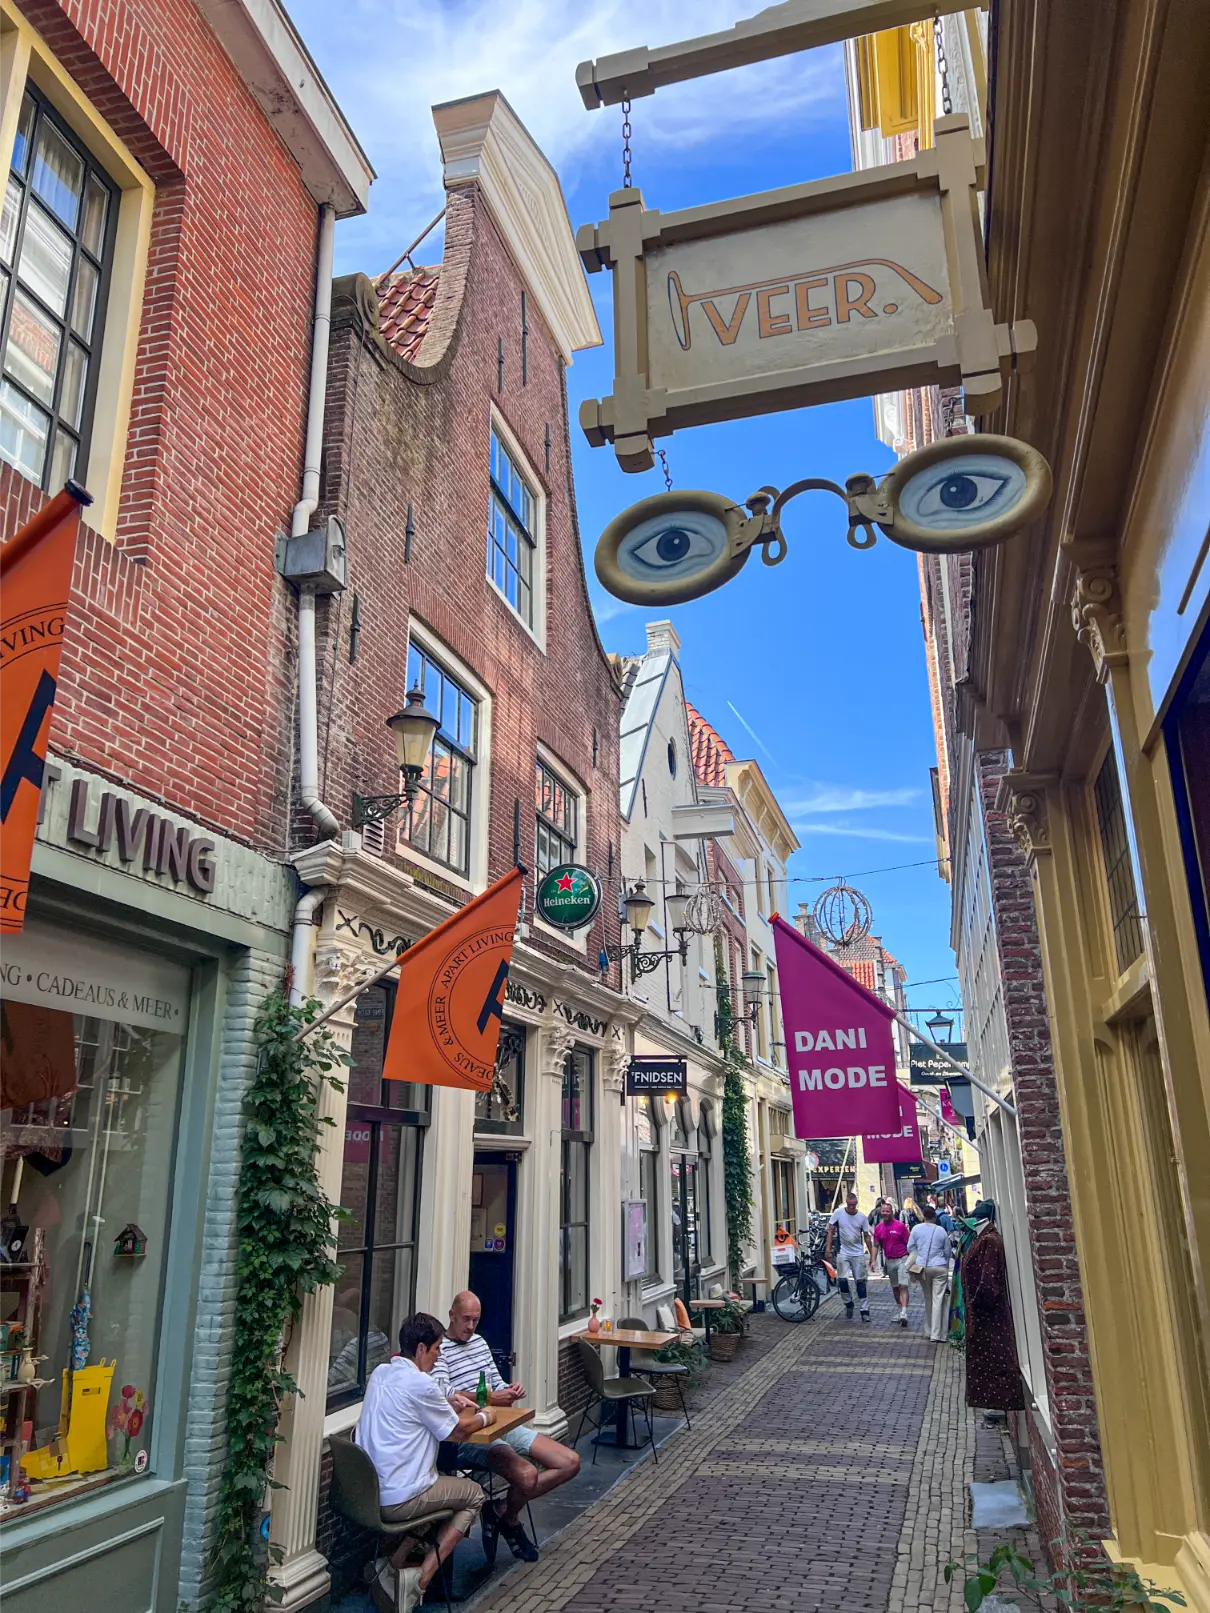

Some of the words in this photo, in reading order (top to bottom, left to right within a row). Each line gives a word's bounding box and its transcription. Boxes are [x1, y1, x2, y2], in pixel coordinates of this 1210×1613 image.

[0, 617, 66, 659] VING
[67, 779, 216, 894] LIVING
[543, 895, 591, 907] Heineken
[440, 951, 469, 990] APART
[470, 931, 514, 954] LIVING
[36, 972, 116, 1008] CADEAUS
[117, 991, 129, 1009] &
[132, 994, 172, 1020] MEER
[435, 996, 451, 1037] MEER
[443, 1036, 455, 1046] &
[794, 1027, 868, 1053] DANI
[798, 1065, 888, 1092] MODE
